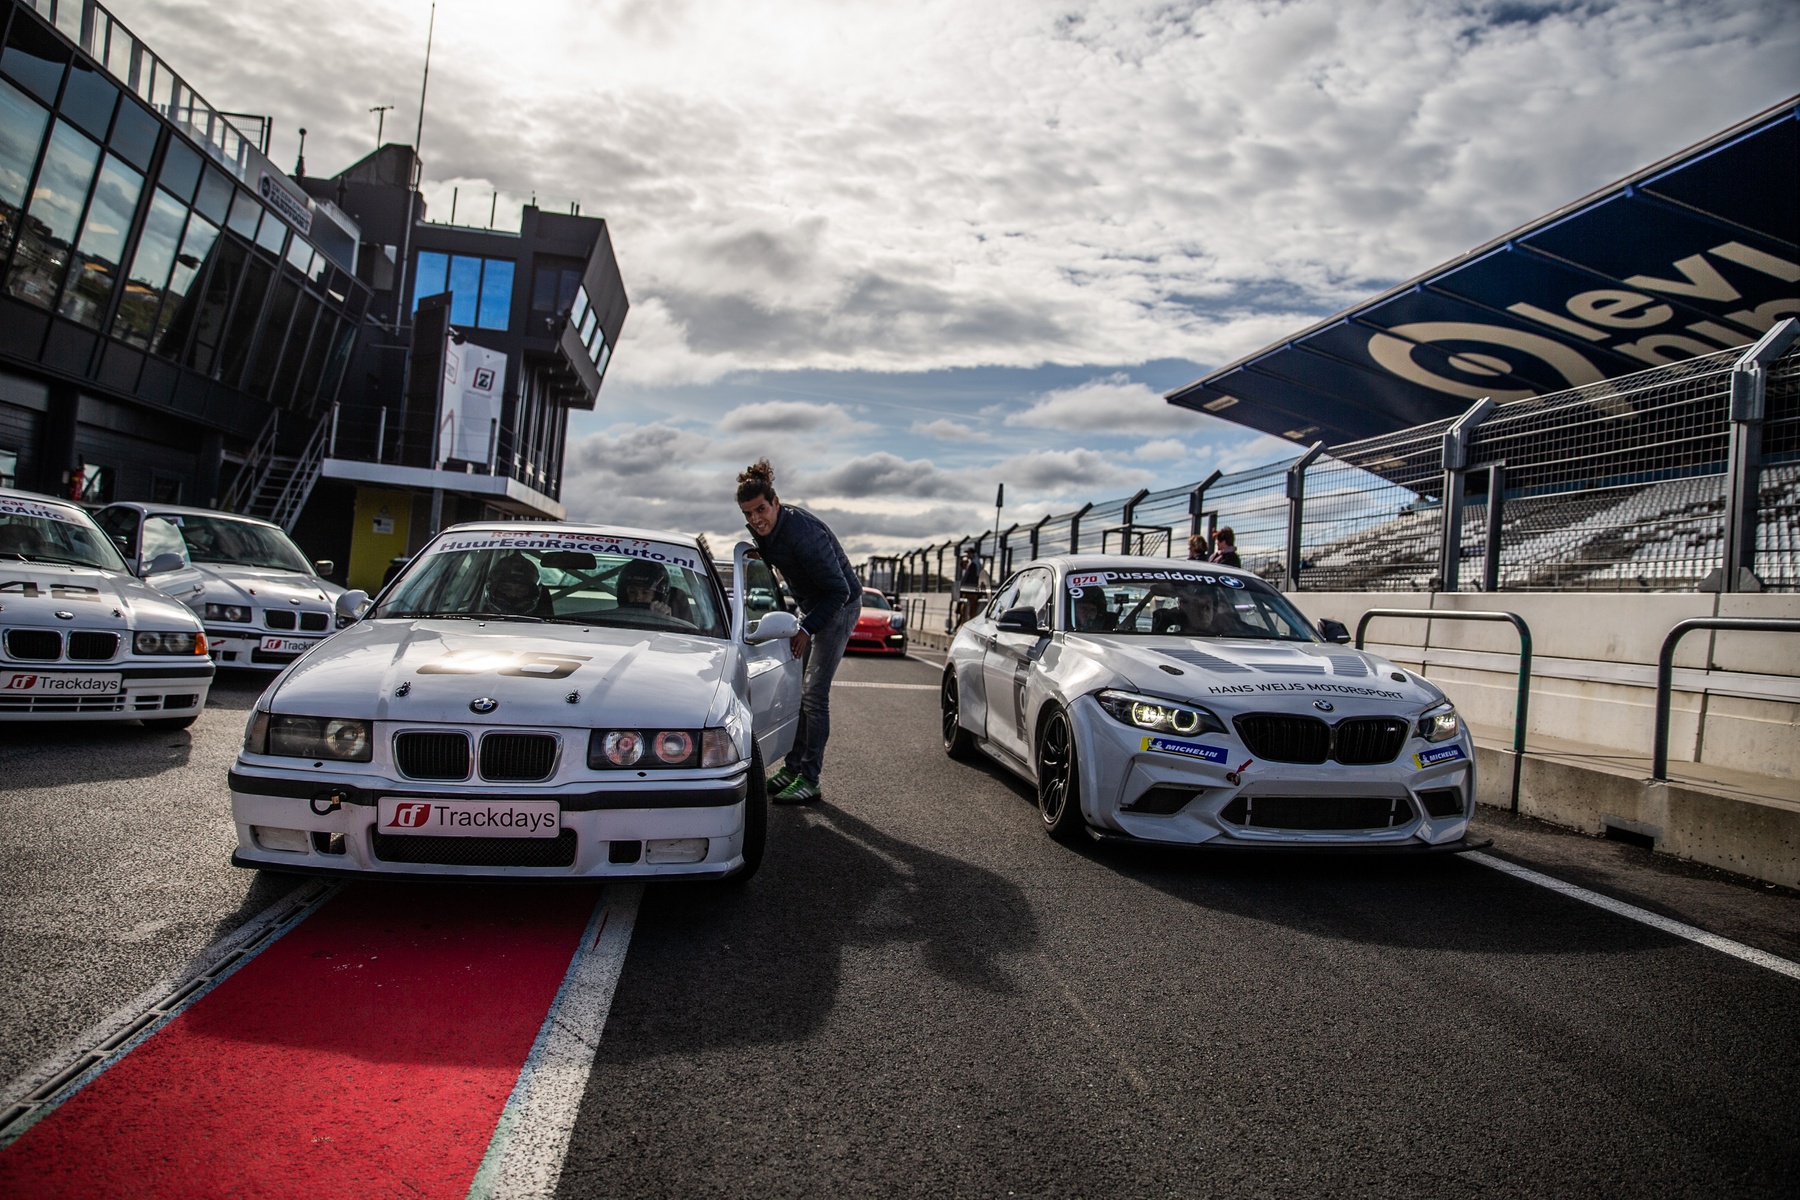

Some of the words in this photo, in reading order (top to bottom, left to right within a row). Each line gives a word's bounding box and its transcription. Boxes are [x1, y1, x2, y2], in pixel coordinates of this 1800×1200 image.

[478, 373, 490, 388] Z
[0, 499, 25, 507] car
[557, 533, 623, 544] racecar
[631, 540, 650, 548] ??
[439, 538, 695, 569] HuurEenRaceAuto.nl
[1072, 575, 1098, 584] 070
[1104, 571, 1217, 585] Dusseldorp
[0, 581, 102, 603] 42
[1068, 587, 1084, 599] 9
[39, 676, 118, 692] Trackdays
[1208, 685, 1254, 694] HANS
[1256, 683, 1305, 692] WEIJS
[1307, 683, 1404, 700] MOTORSPORT
[1165, 744, 1218, 758] MICHELIN
[1429, 749, 1459, 762] MICHELIN
[434, 806, 556, 833] Trackdays
